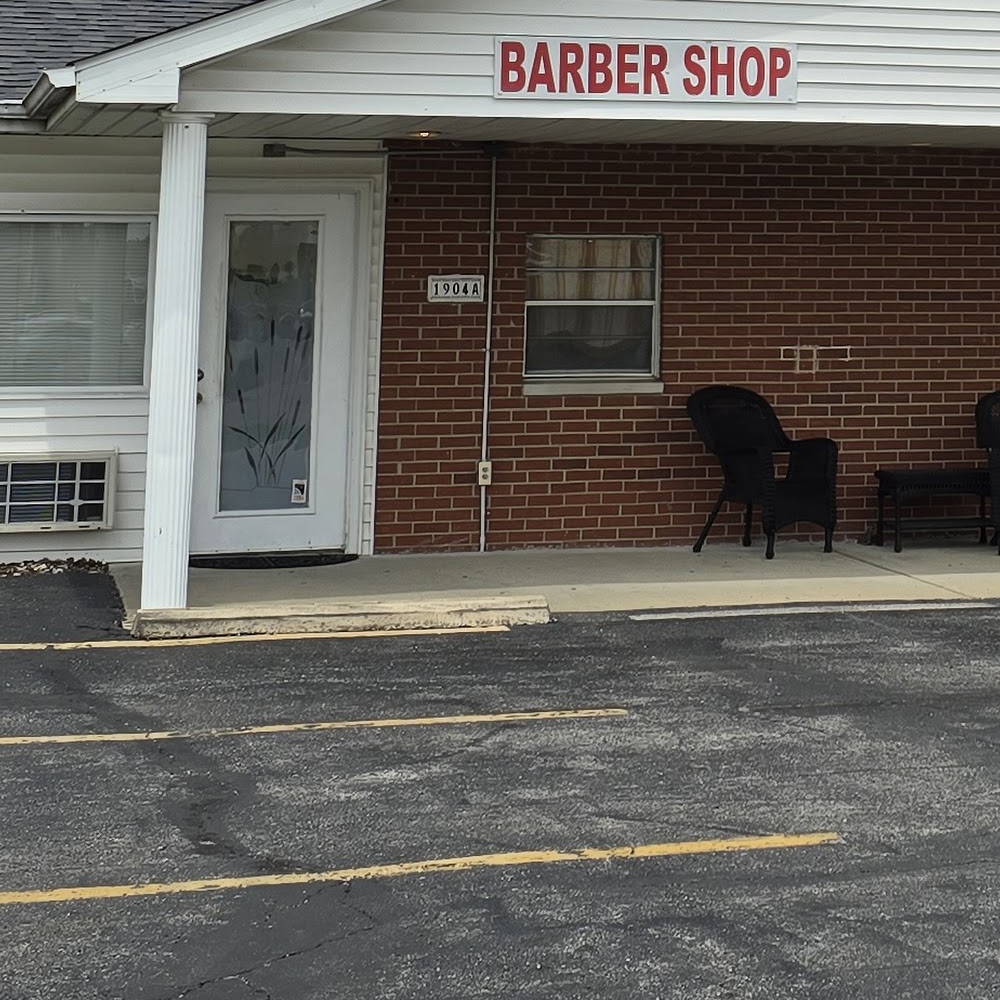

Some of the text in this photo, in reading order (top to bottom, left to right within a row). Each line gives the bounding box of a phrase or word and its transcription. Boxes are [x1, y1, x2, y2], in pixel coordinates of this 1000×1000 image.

[500, 41, 792, 97] BARBER SHOP
[434, 282, 479, 296] 1904A
